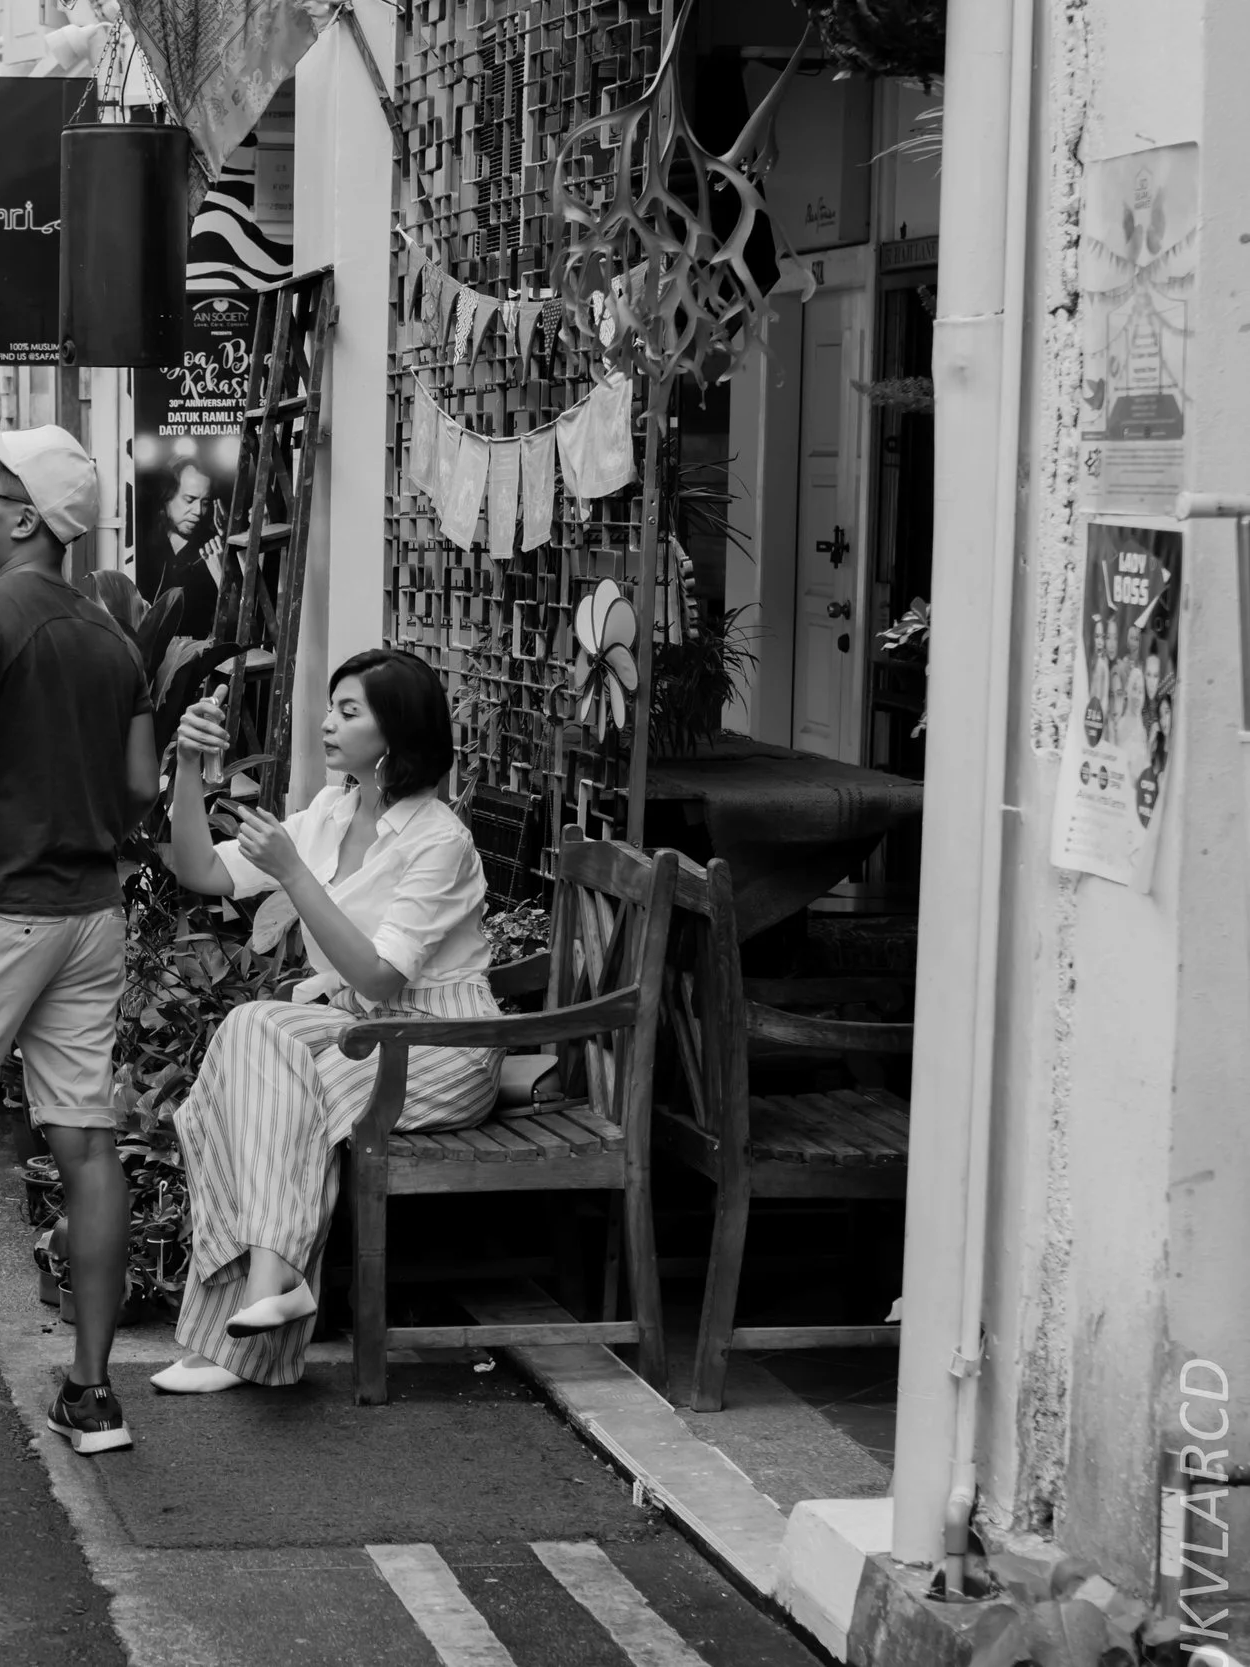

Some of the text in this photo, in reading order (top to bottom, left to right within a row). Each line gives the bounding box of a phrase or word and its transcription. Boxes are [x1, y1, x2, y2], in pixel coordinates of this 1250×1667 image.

[193, 312, 249, 322] AIN SOCIETY
[9, 342, 60, 351] 100% MUSLIM
[17, 352, 27, 361] US
[185, 399, 236, 408] ANNIVERSARY
[167, 411, 200, 423] DATUK
[202, 411, 234, 422] RAMLI
[159, 424, 240, 436] DATO' KHADIJAH
[1118, 551, 1147, 574] LADY
[1113, 575, 1150, 606] BOSS
